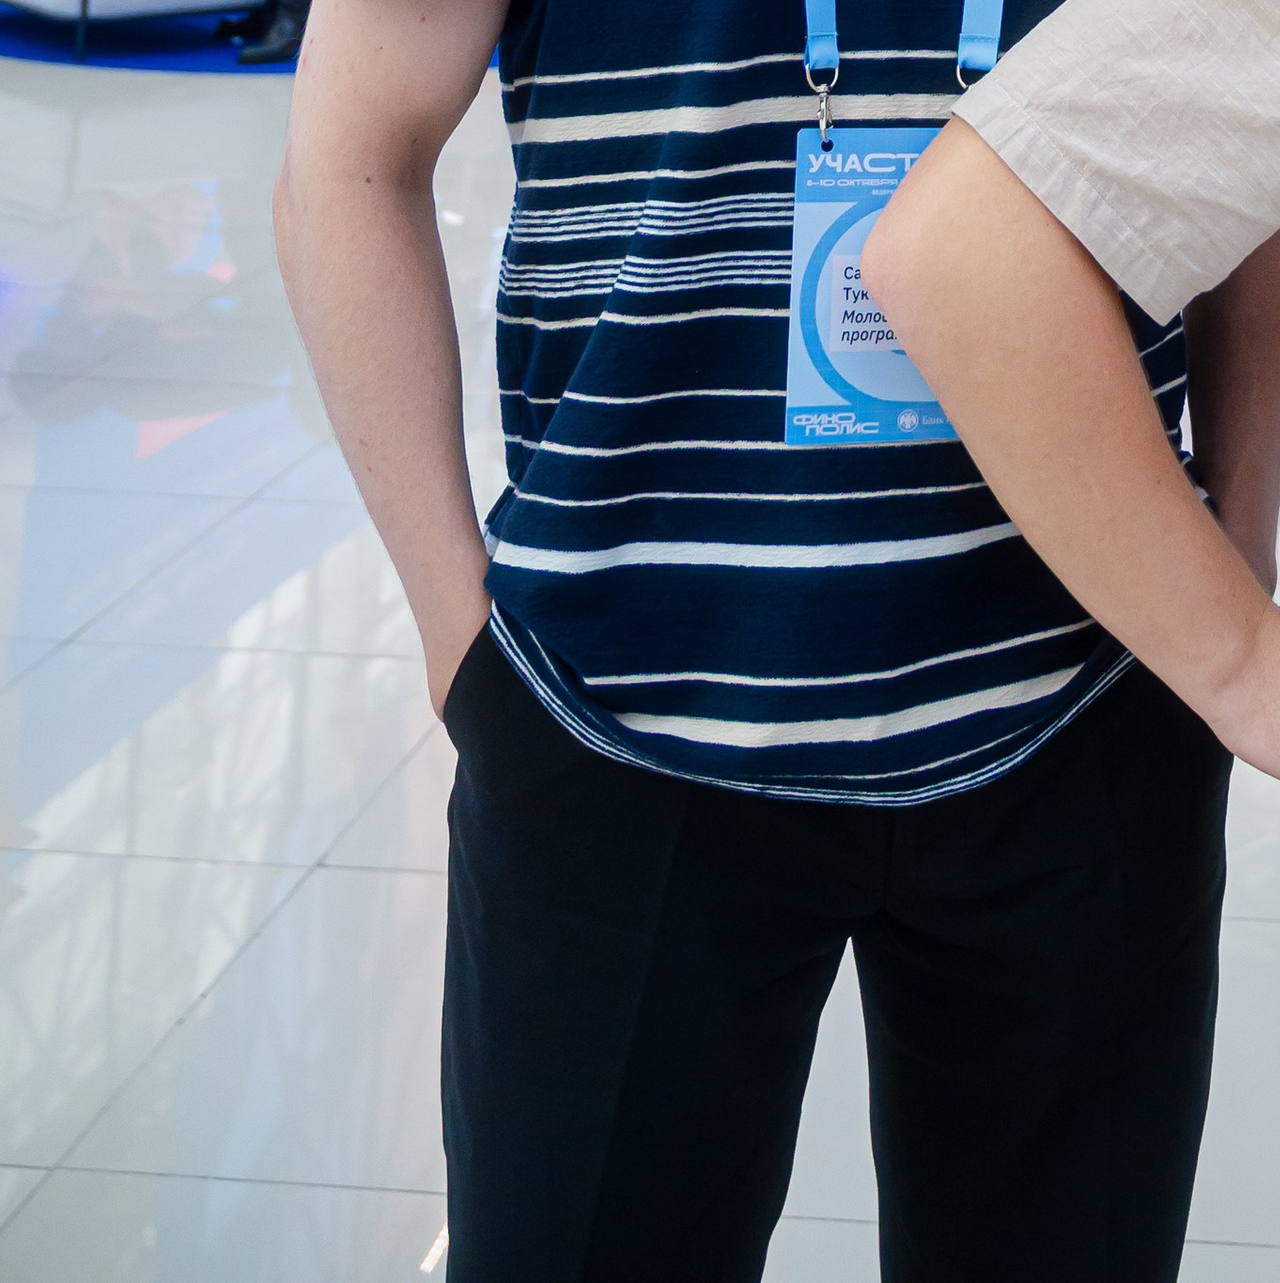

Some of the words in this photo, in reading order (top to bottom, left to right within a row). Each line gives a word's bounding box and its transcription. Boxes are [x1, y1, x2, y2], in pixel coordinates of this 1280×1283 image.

[807, 152, 920, 174] УЧАСТ
[837, 178, 899, 187] ОКТЯБРЯ
[843, 266, 862, 280] Са
[842, 287, 870, 304] Тук
[841, 309, 888, 324] Моло
[841, 329, 898, 345] програ
[793, 411, 856, 426] ФИНО
[805, 421, 880, 436] ПОЛИС
